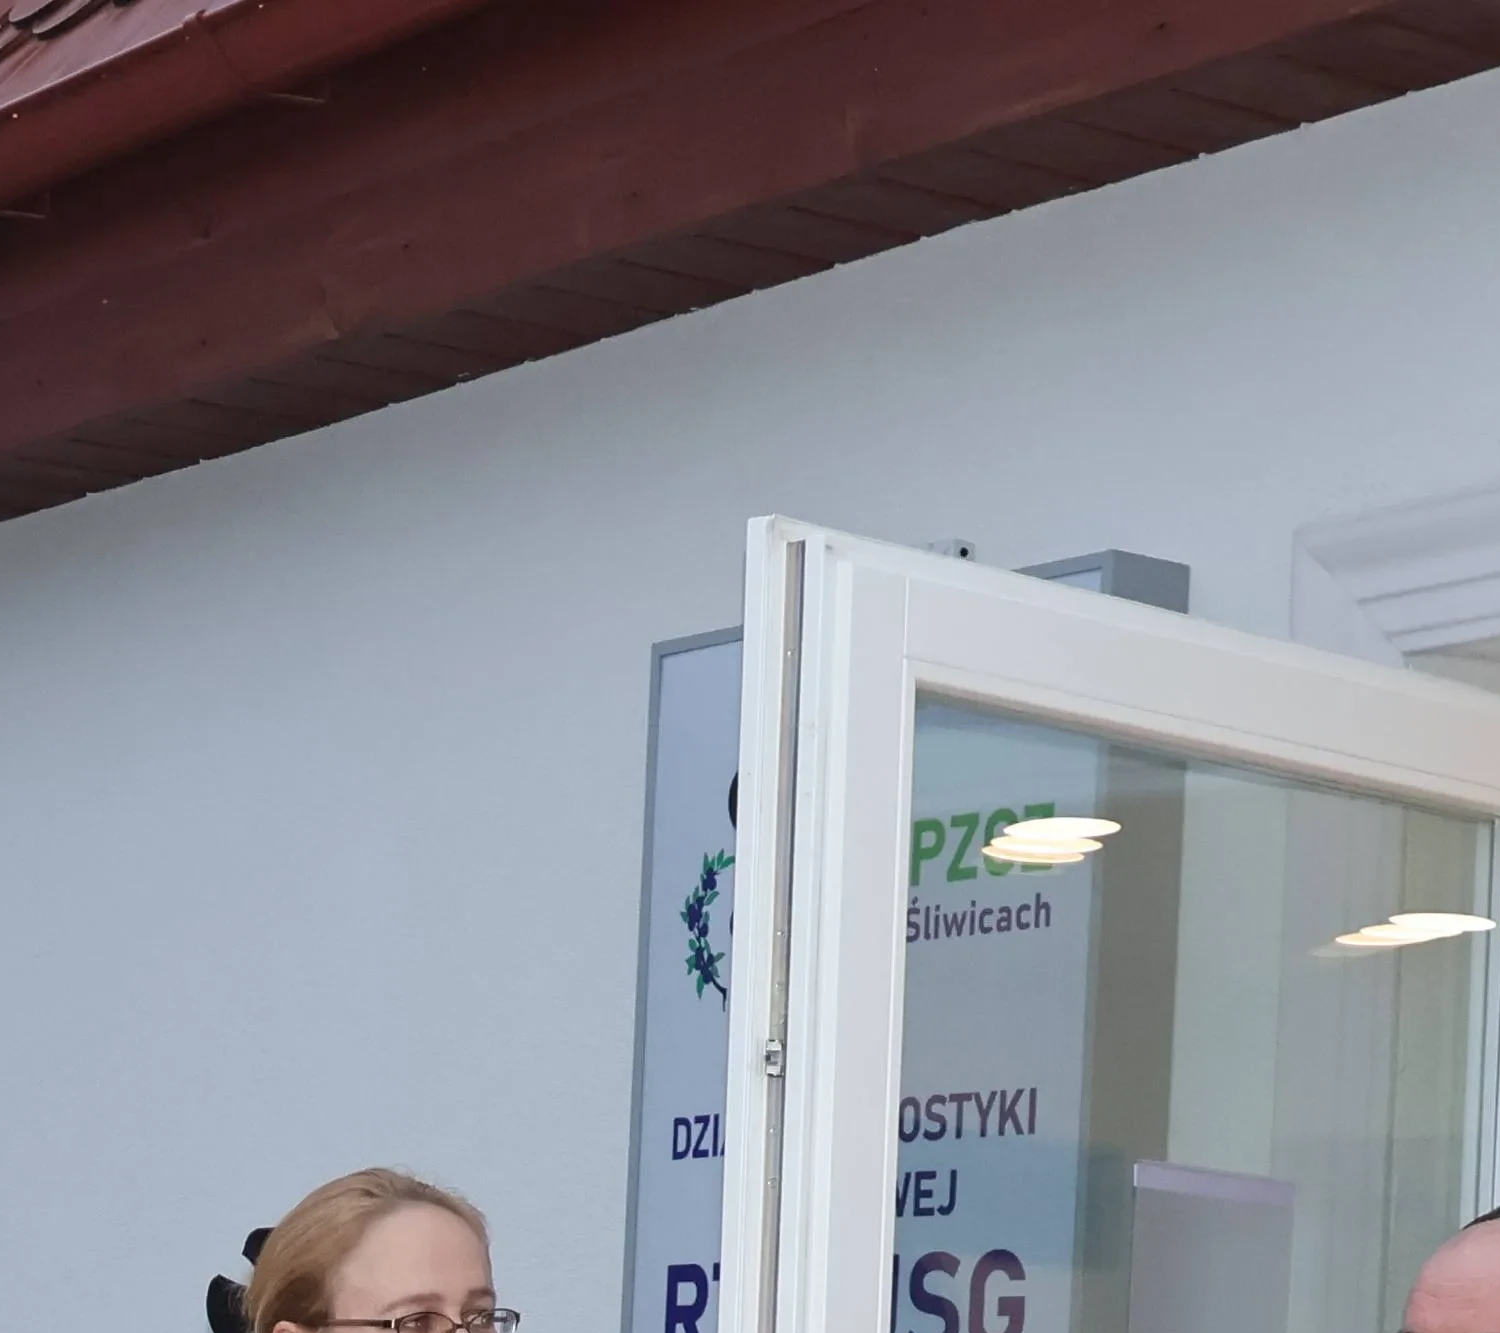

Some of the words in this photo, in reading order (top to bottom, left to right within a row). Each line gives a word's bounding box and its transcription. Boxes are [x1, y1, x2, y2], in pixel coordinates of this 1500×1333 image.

[906, 892, 1052, 943] Śliwicach
[672, 1113, 726, 1160] DZI
[899, 1087, 1038, 1143] OSTYKI
